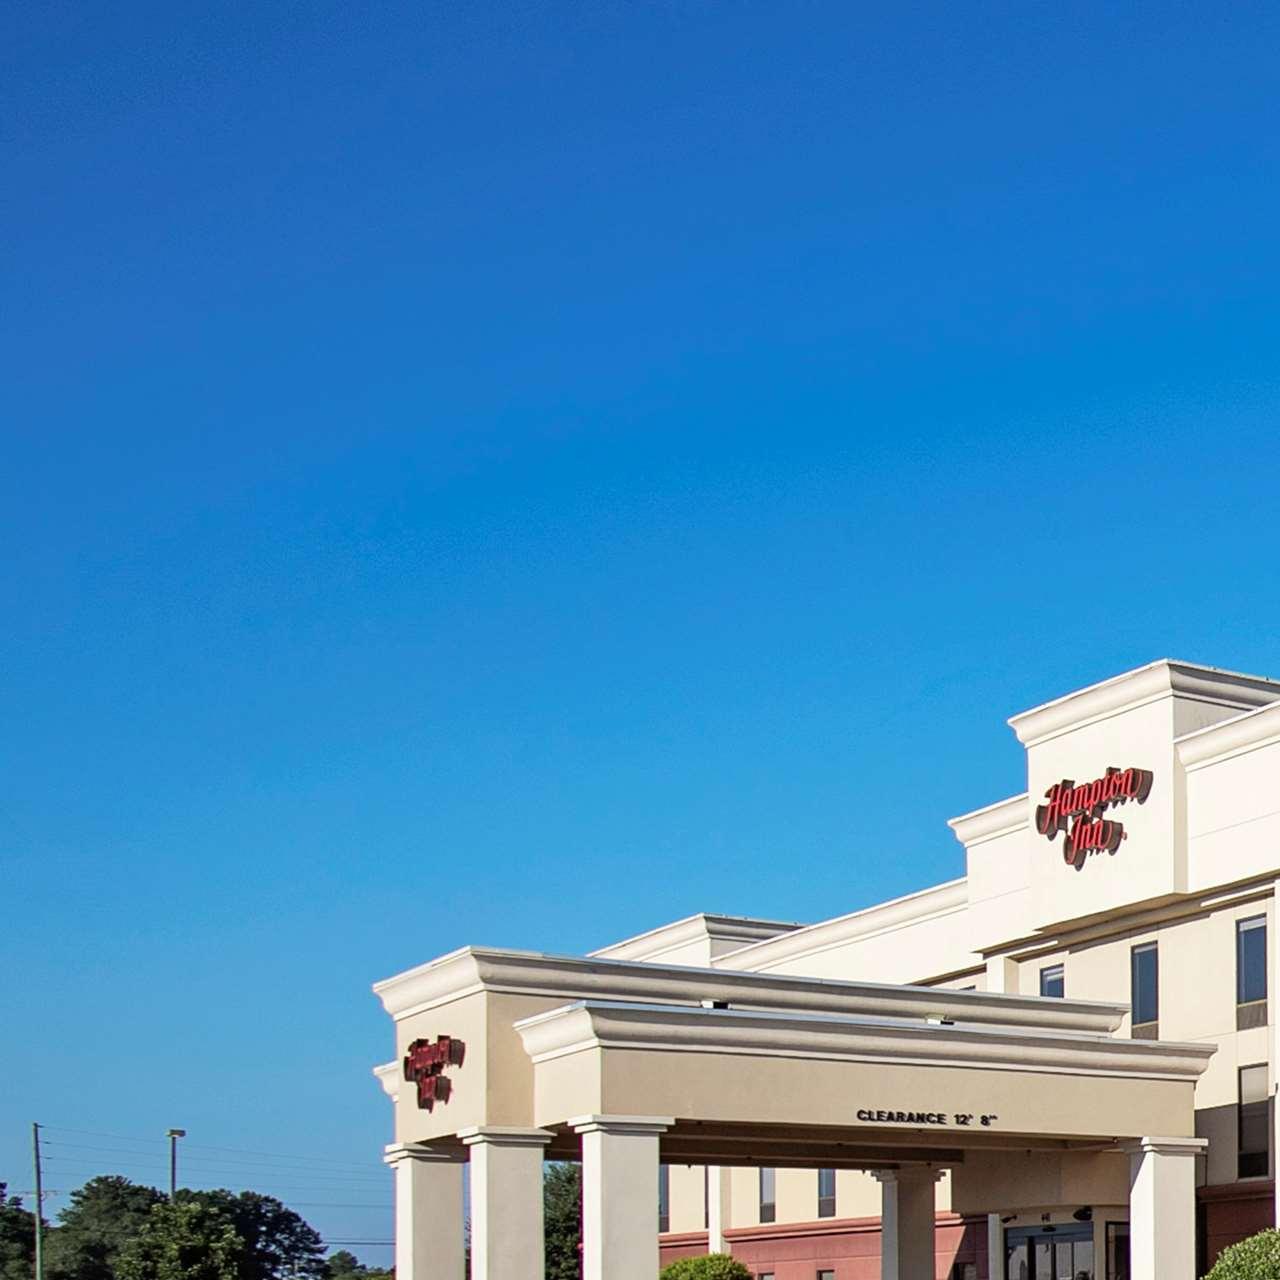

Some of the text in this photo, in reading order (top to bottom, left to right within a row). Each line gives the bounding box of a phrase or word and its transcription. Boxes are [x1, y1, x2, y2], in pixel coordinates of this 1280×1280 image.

[1037, 767, 1150, 838] Hampton
[1064, 814, 1121, 868] Inn
[856, 1109, 947, 1126] CLEARANCE
